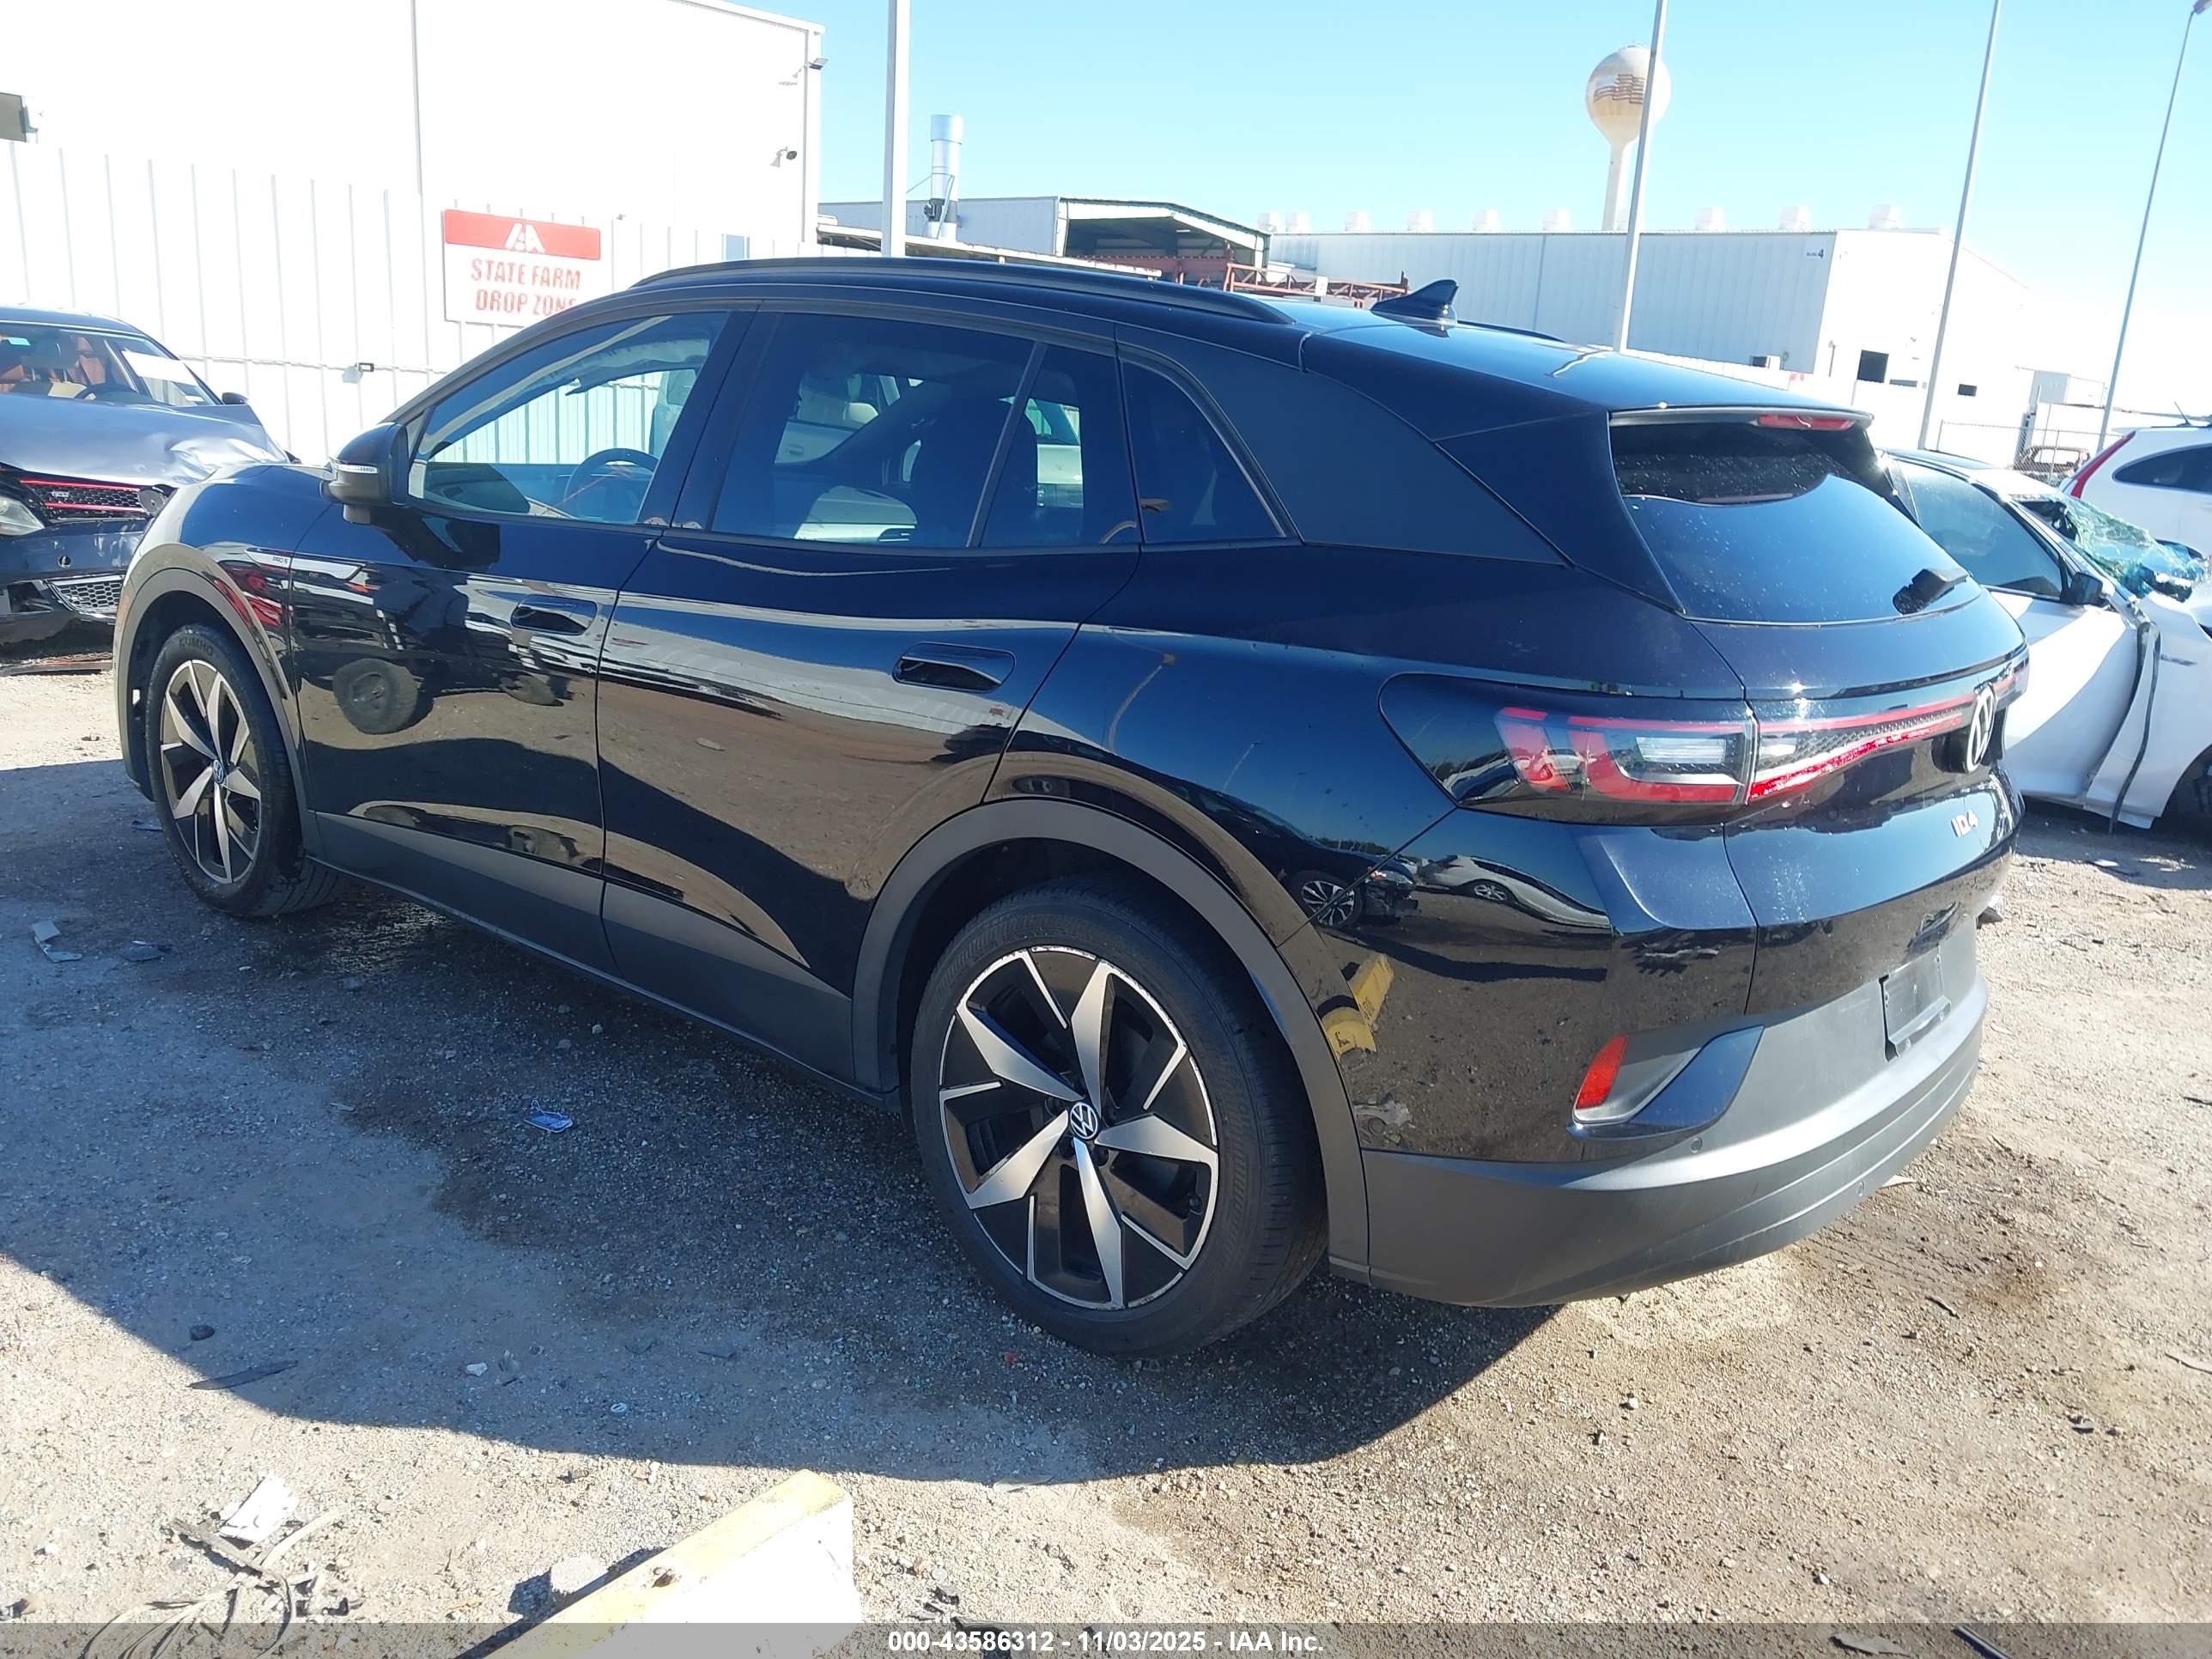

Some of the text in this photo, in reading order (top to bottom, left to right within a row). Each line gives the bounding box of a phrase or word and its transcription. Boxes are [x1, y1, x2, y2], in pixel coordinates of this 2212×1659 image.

[471, 258, 581, 290] STATE FARM
[476, 289, 528, 315] DROP
[179, 636, 214, 656] KUMHO
